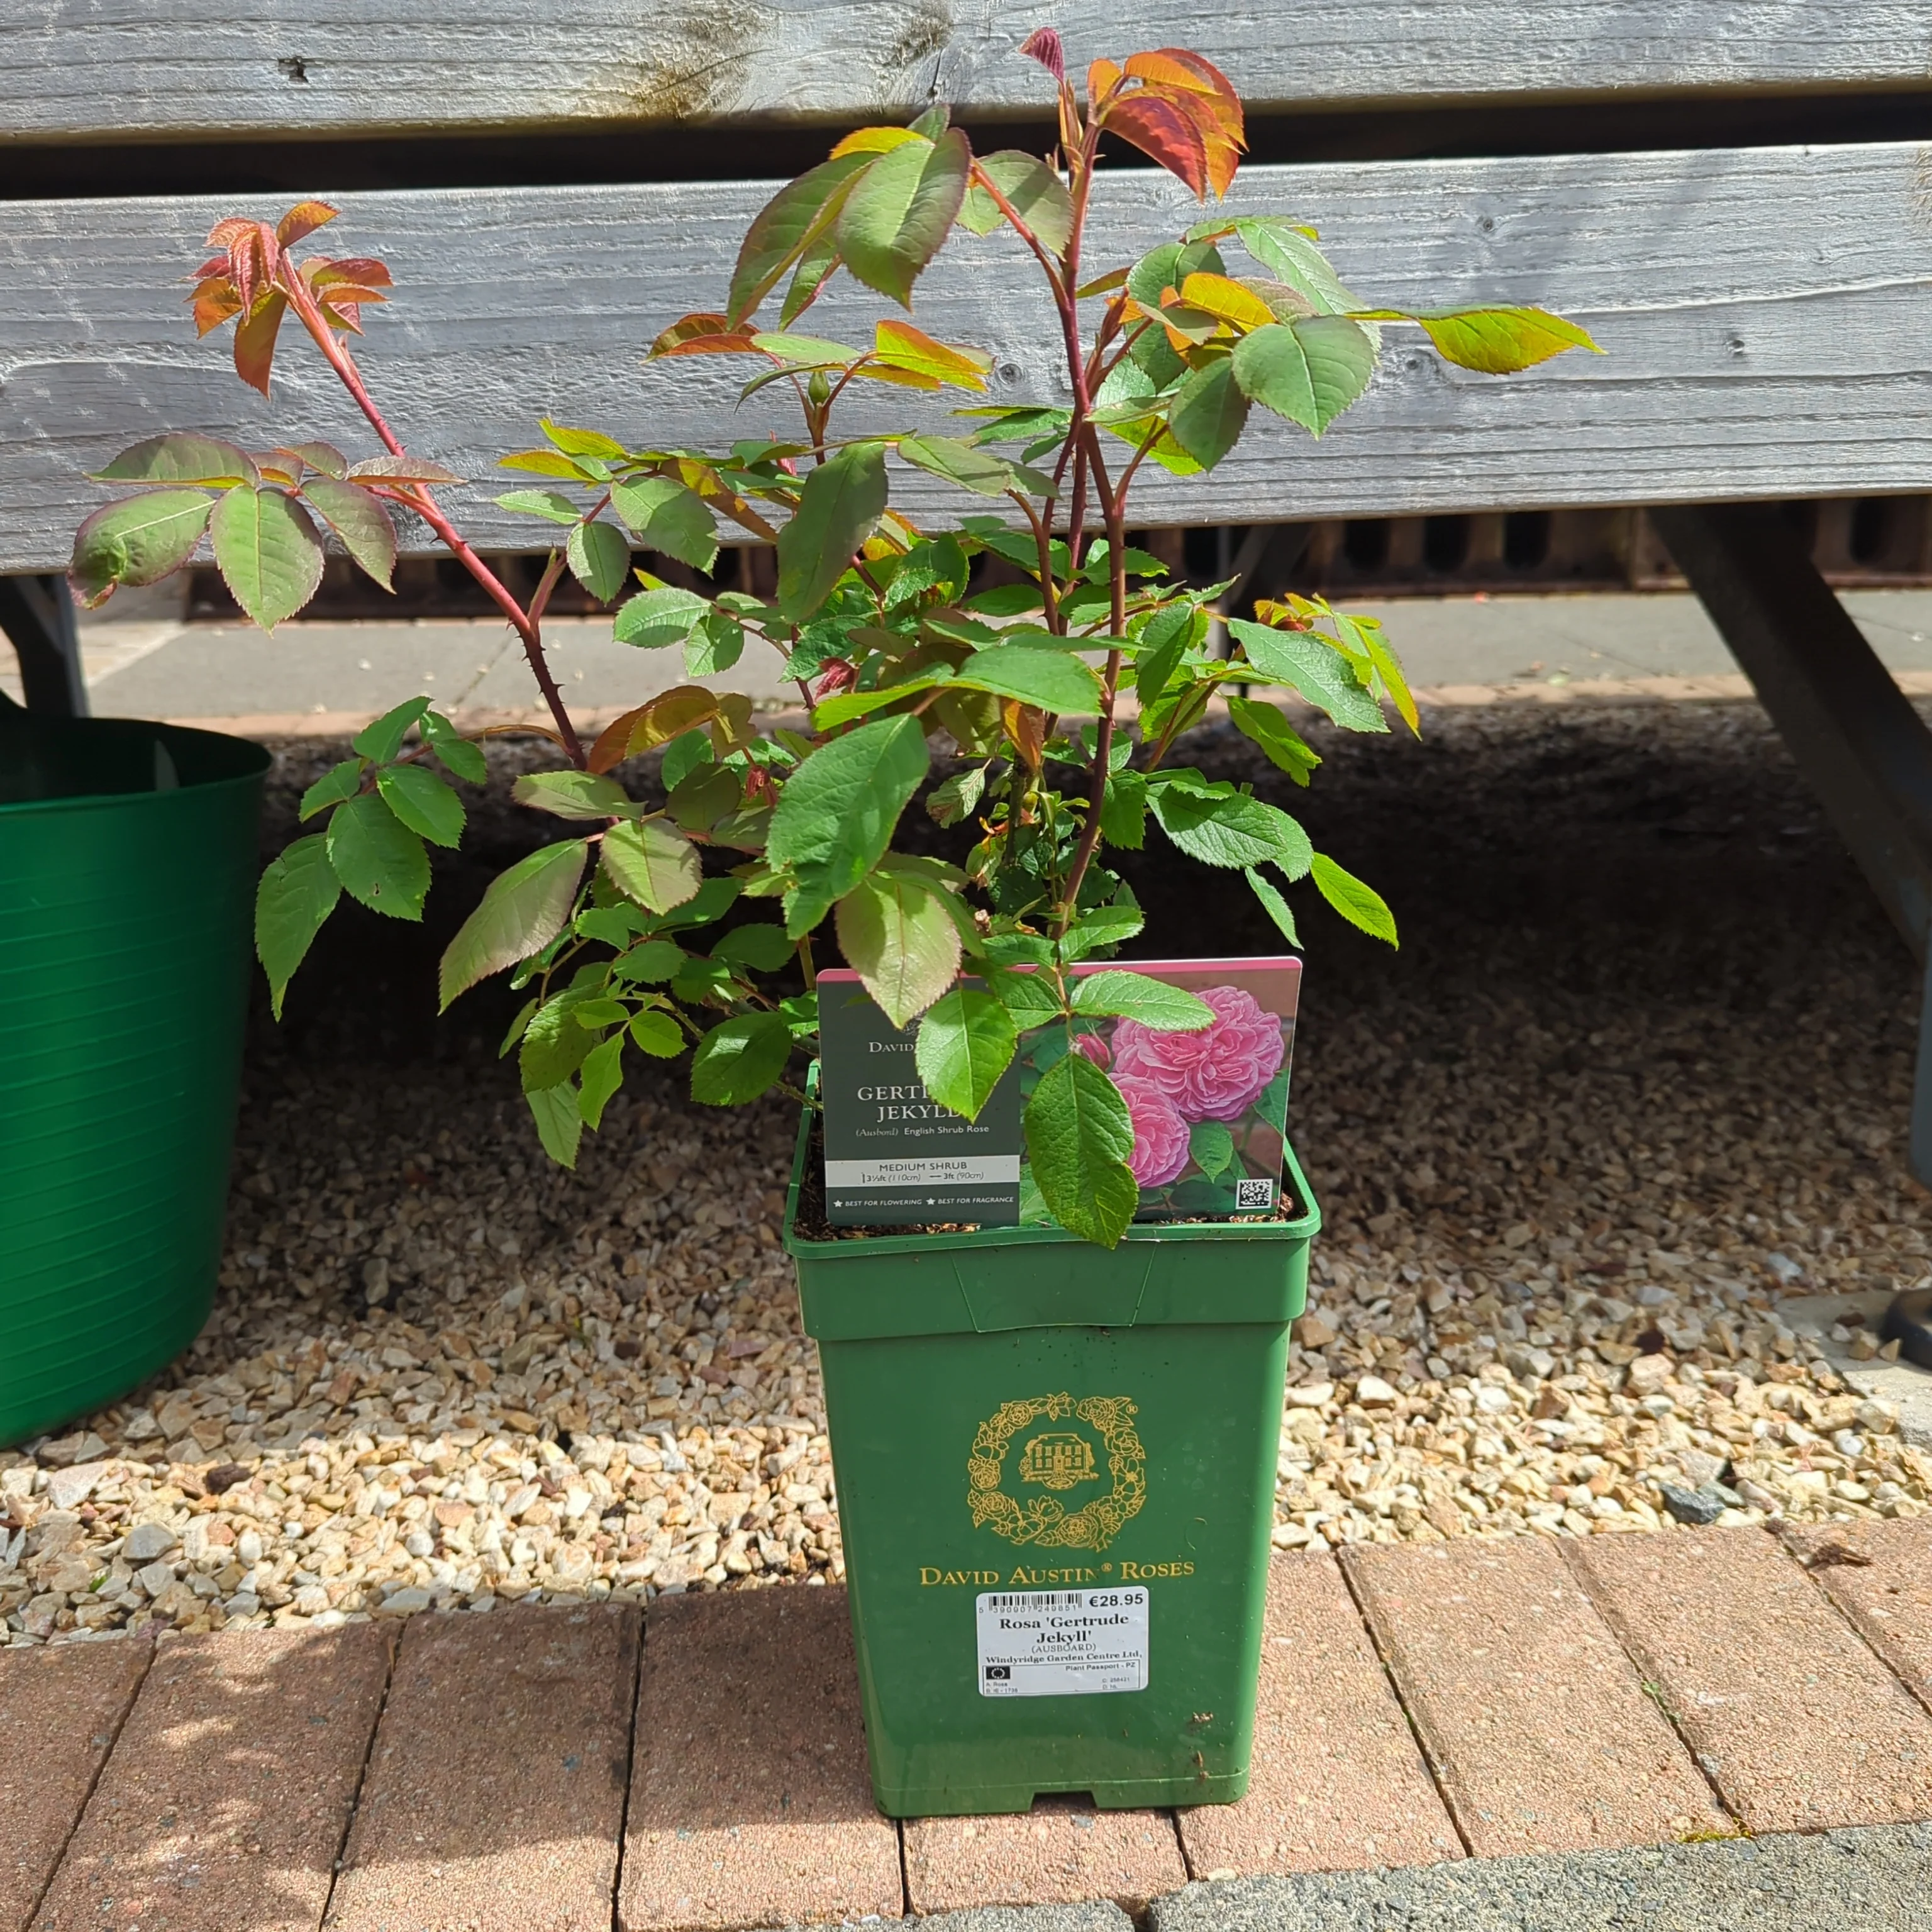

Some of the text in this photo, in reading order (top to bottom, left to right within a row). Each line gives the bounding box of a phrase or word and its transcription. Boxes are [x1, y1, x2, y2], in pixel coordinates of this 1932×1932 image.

[869, 1041, 914, 1053] DAVID
[904, 1127, 935, 1136] English
[937, 1125, 964, 1134] Shrub
[966, 1124, 989, 1133] Rose
[879, 1162, 967, 1172] MEDIUM SHRUB
[888, 1173, 921, 1183] (110cm)
[957, 1171, 984, 1181] (90cm)
[919, 1567, 1000, 1585] DAVID
[1119, 1561, 1194, 1580] ROSES
[1089, 1592, 1144, 1607] €28.95
[999, 1613, 1130, 1629] Rosa 'Gertrude
[1036, 1630, 1092, 1645] Jekyll'
[1031, 1642, 1097, 1653] (AUSBOARD)
[985, 1655, 1045, 1665] Windyridge
[1047, 1653, 1084, 1662] Garden
[1086, 1652, 1120, 1660] Centre
[1087, 1663, 1119, 1671] Passport
